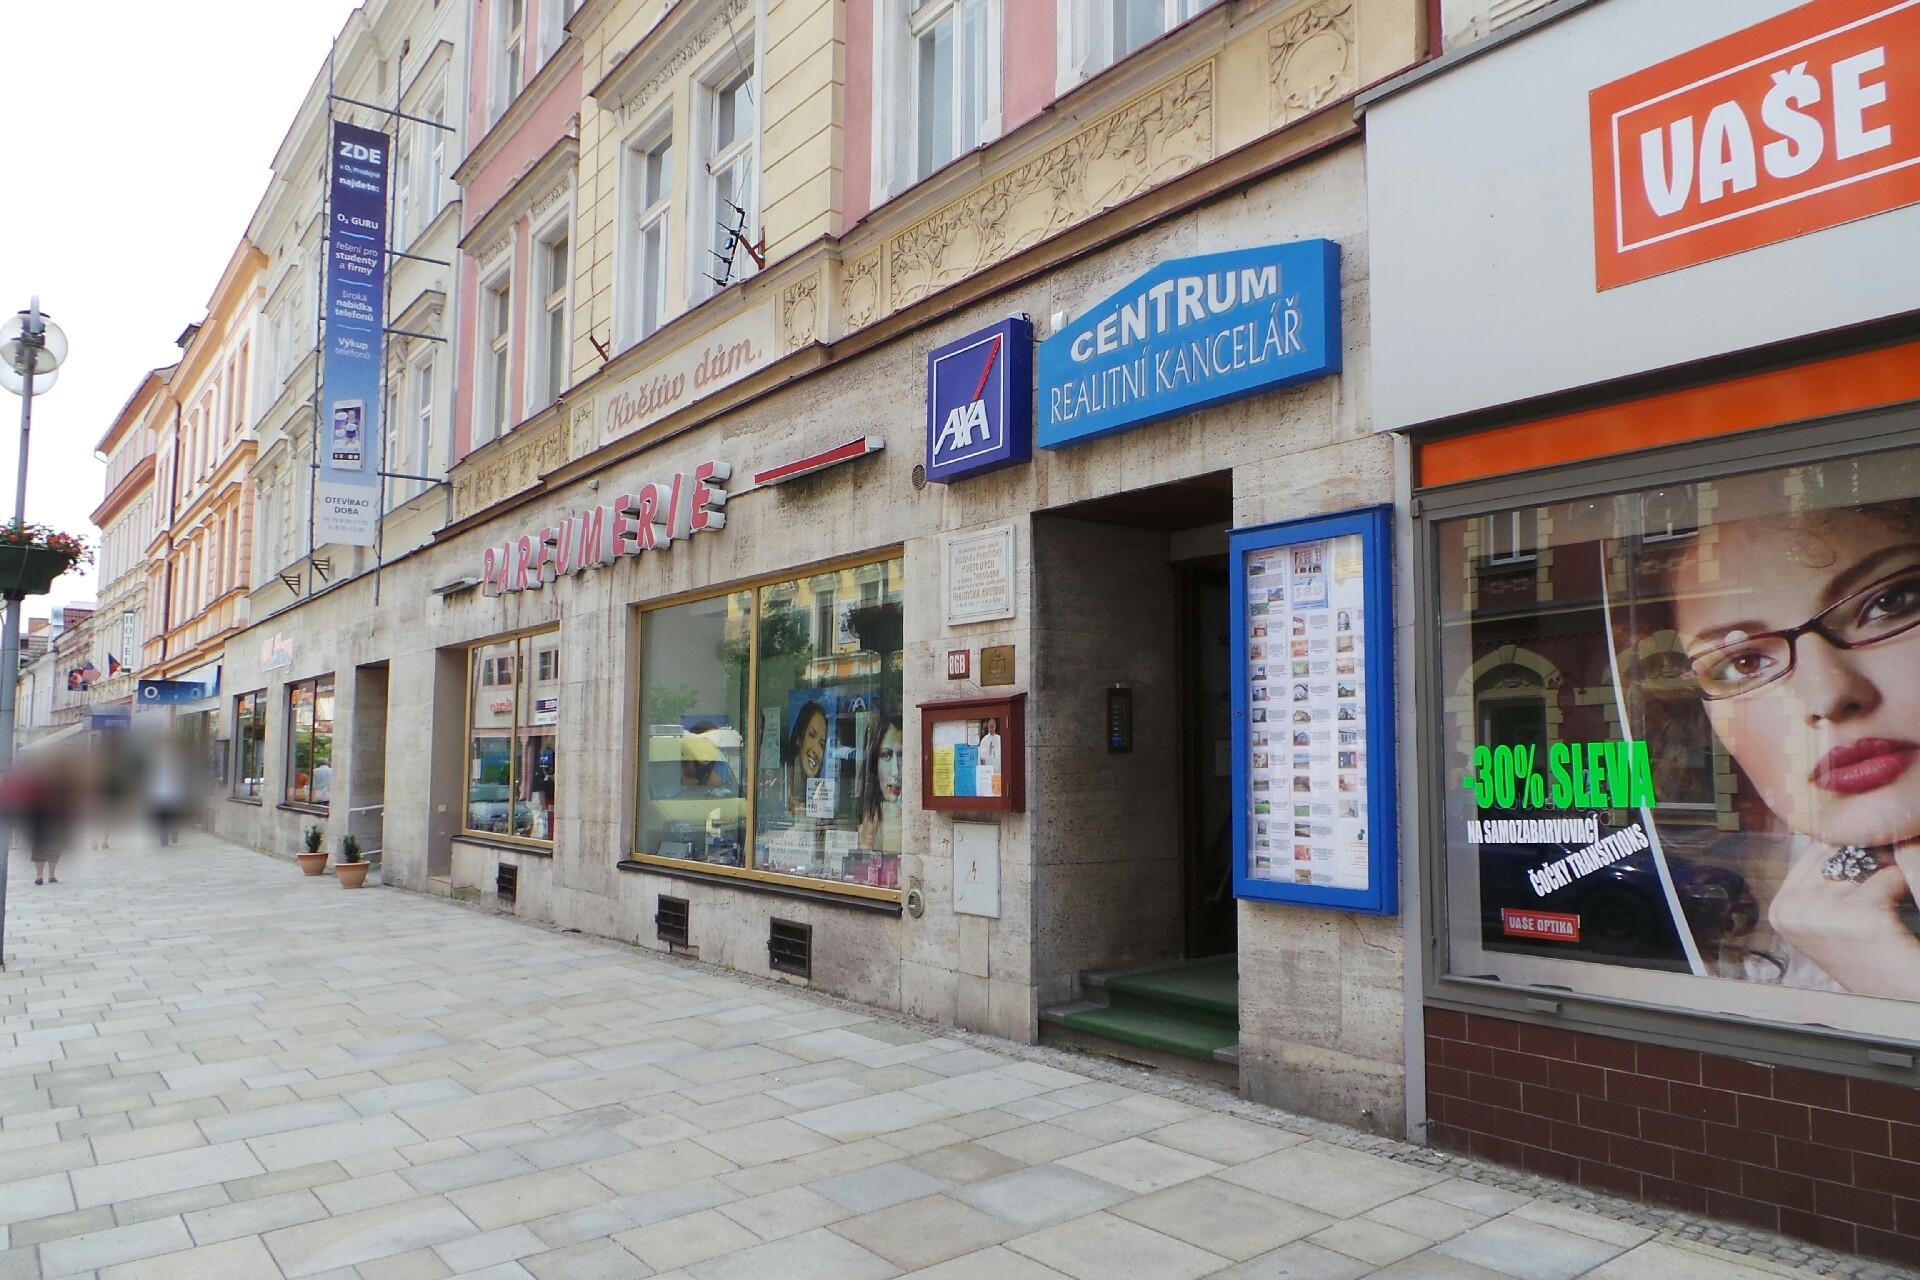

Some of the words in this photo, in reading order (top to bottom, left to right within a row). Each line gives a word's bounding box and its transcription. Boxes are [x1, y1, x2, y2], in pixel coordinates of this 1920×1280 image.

[1640, 46, 1892, 217] VAŠE
[339, 140, 381, 165] ZDE
[339, 177, 380, 192] najdete:
[351, 217, 379, 230] GURU
[336, 251, 377, 268] studenty
[363, 247, 378, 258] pro
[347, 261, 373, 276] firmy
[1070, 264, 1278, 362] CENTRUM
[338, 336, 369, 350] Výkup
[1051, 346, 1147, 424] REALITNÍ
[1155, 295, 1302, 393] KANCELÁŘ
[606, 371, 686, 434] Květův
[934, 398, 992, 456] AXA
[334, 506, 359, 515] DOBA
[482, 459, 716, 598] PARFUMERIE
[125, 615, 133, 666] HOTEL
[1463, 743, 1545, 809] -30%
[1550, 740, 1656, 809] SLEVA
[1467, 820, 1484, 844] NA
[1484, 814, 1599, 844] SAMOZABARVOVACÍ
[1527, 857, 1574, 898] ČOČKY
[1566, 822, 1650, 880] TRANSITIONS
[1508, 915, 1535, 931] VAŠE
[1537, 918, 1574, 936] OPTIKA
